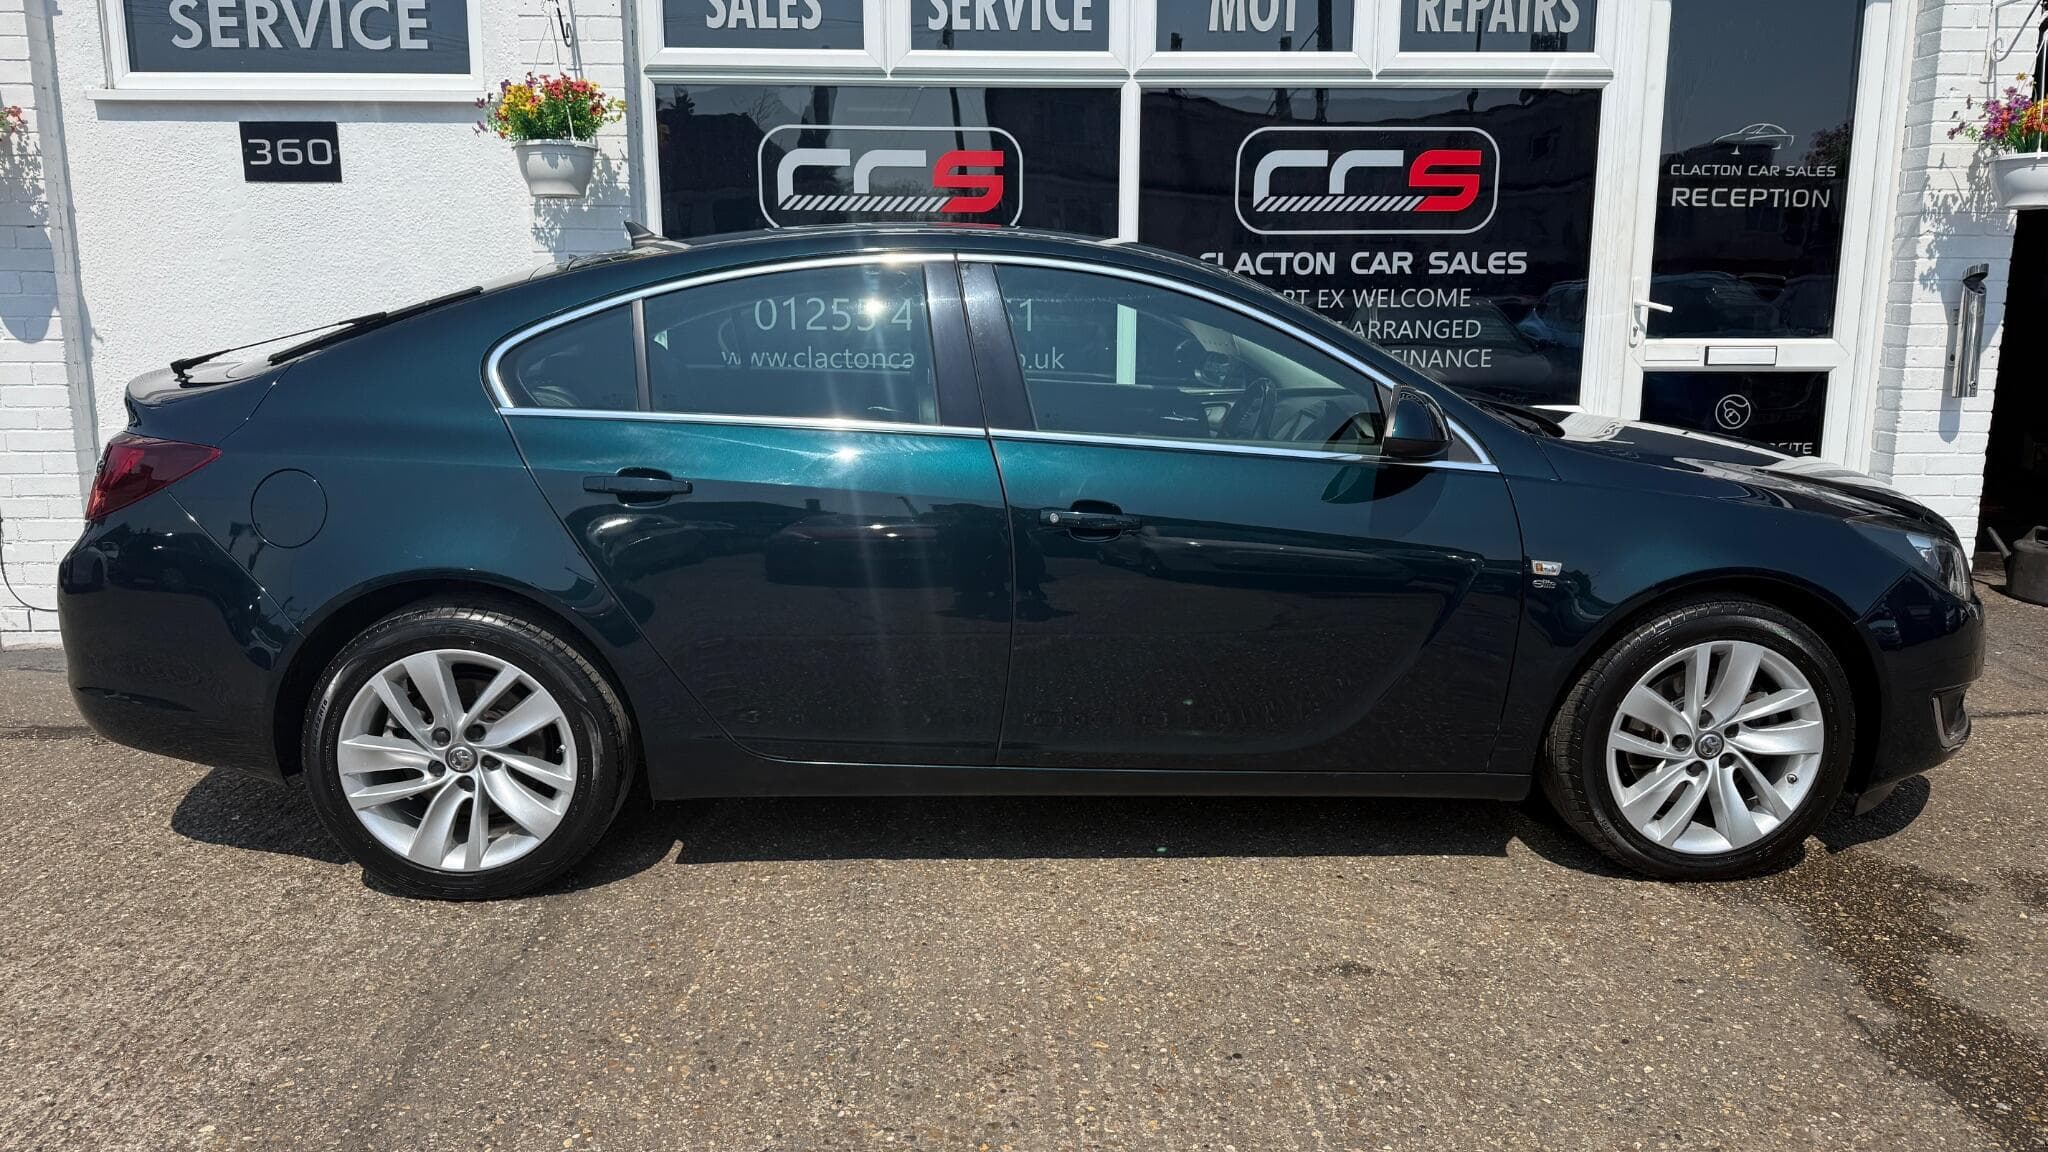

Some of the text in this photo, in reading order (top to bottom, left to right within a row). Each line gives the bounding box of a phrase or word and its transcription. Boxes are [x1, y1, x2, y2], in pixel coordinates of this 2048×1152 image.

[168, 0, 430, 50] SERVICE
[1416, 0, 1579, 33] REPAIRS
[247, 139, 333, 165] 360
[1670, 164, 1837, 177] CLACTON CAR SALES
[1671, 187, 1831, 208] RECEPTION
[1351, 252, 1413, 275] CAR
[1428, 252, 1528, 275] SALES
[1317, 289, 1345, 309] EX
[1353, 288, 1472, 309] WELCOME
[1352, 320, 1482, 339] ARRANGED
[1391, 349, 1493, 368] INANCE
